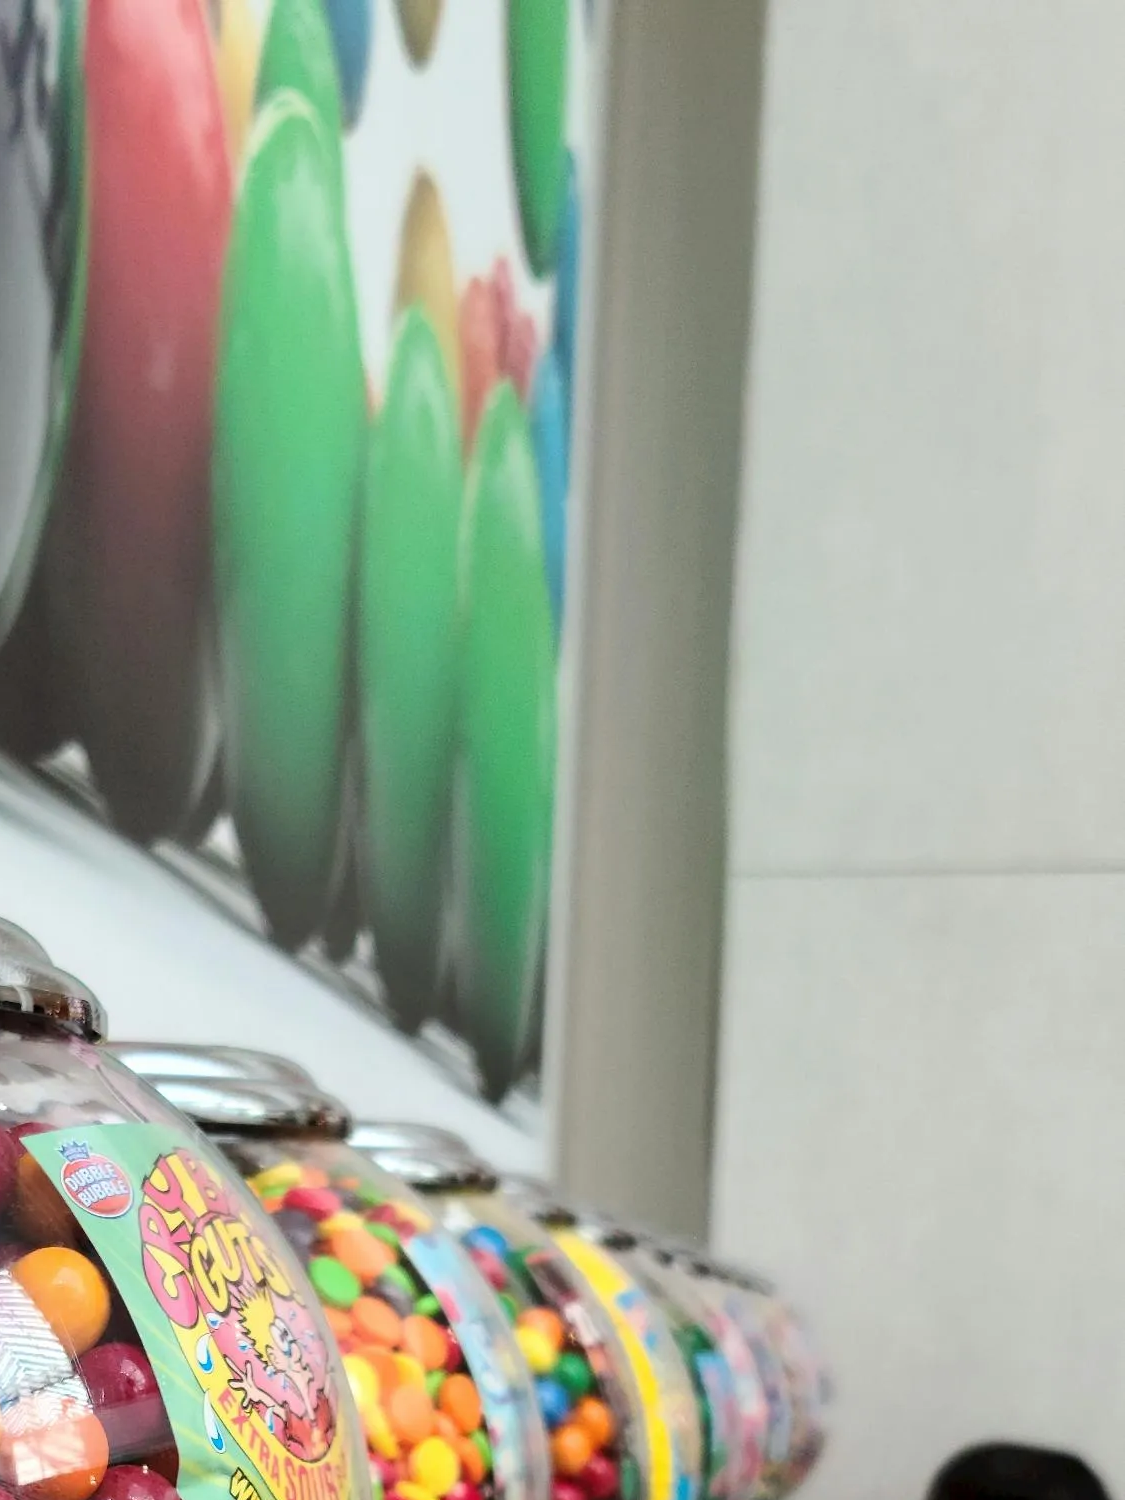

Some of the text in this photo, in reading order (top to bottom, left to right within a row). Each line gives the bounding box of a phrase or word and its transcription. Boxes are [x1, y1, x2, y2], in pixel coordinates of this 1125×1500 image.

[64, 1163, 118, 1192] DUBBLE
[78, 1180, 130, 1208] BUBBLE
[138, 1154, 200, 1330] CRY
[217, 1387, 281, 1488] EXTRA
